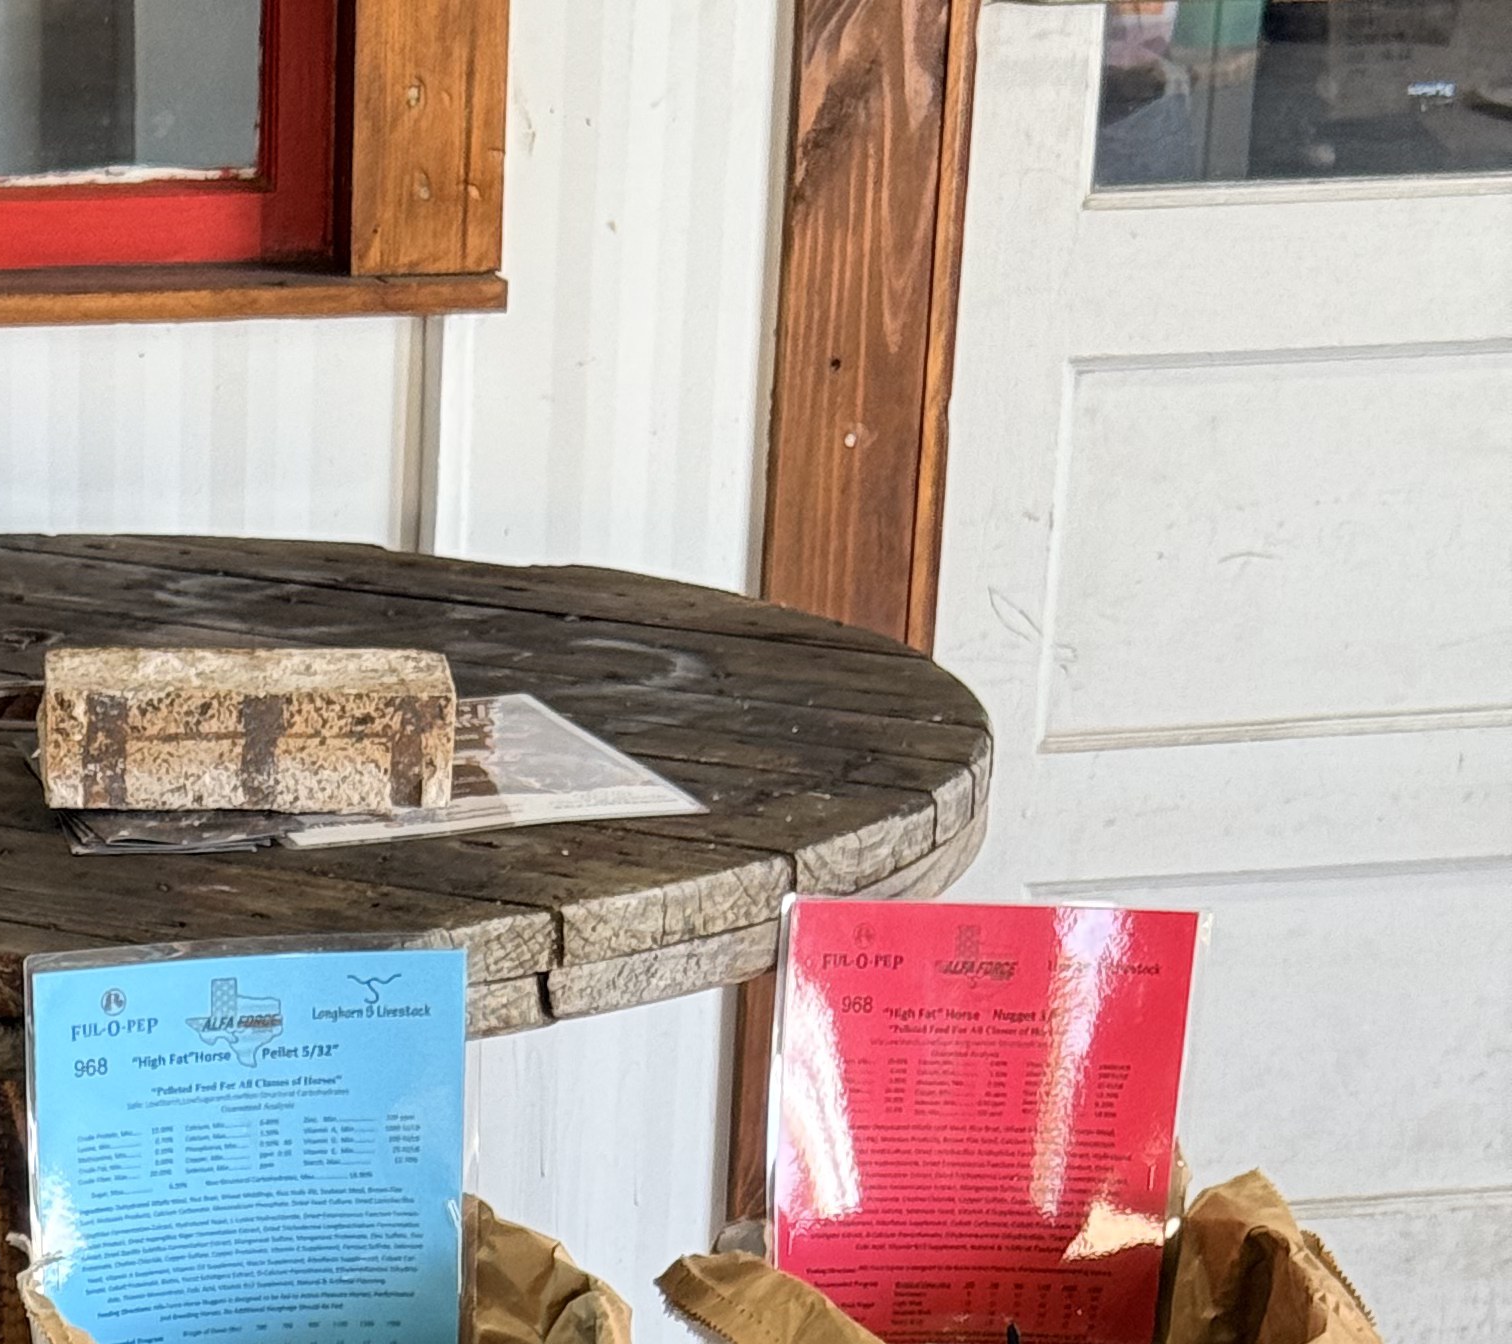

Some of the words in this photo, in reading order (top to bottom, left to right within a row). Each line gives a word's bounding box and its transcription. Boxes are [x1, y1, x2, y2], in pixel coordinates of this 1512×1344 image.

[822, 953, 904, 970] FUL-O-PEP
[312, 1006, 363, 1023] Longhorn
[377, 1004, 431, 1018] Livestock
[841, 995, 873, 1014] 968
[202, 1015, 235, 1032] ALFA
[945, 1008, 980, 1021] Horse
[992, 1008, 1036, 1024] Nugget
[71, 1017, 159, 1042] FUL-O-PEP
[262, 1047, 300, 1060] Pellet
[301, 1044, 340, 1060] 5/32"
[74, 1057, 108, 1078] 968
